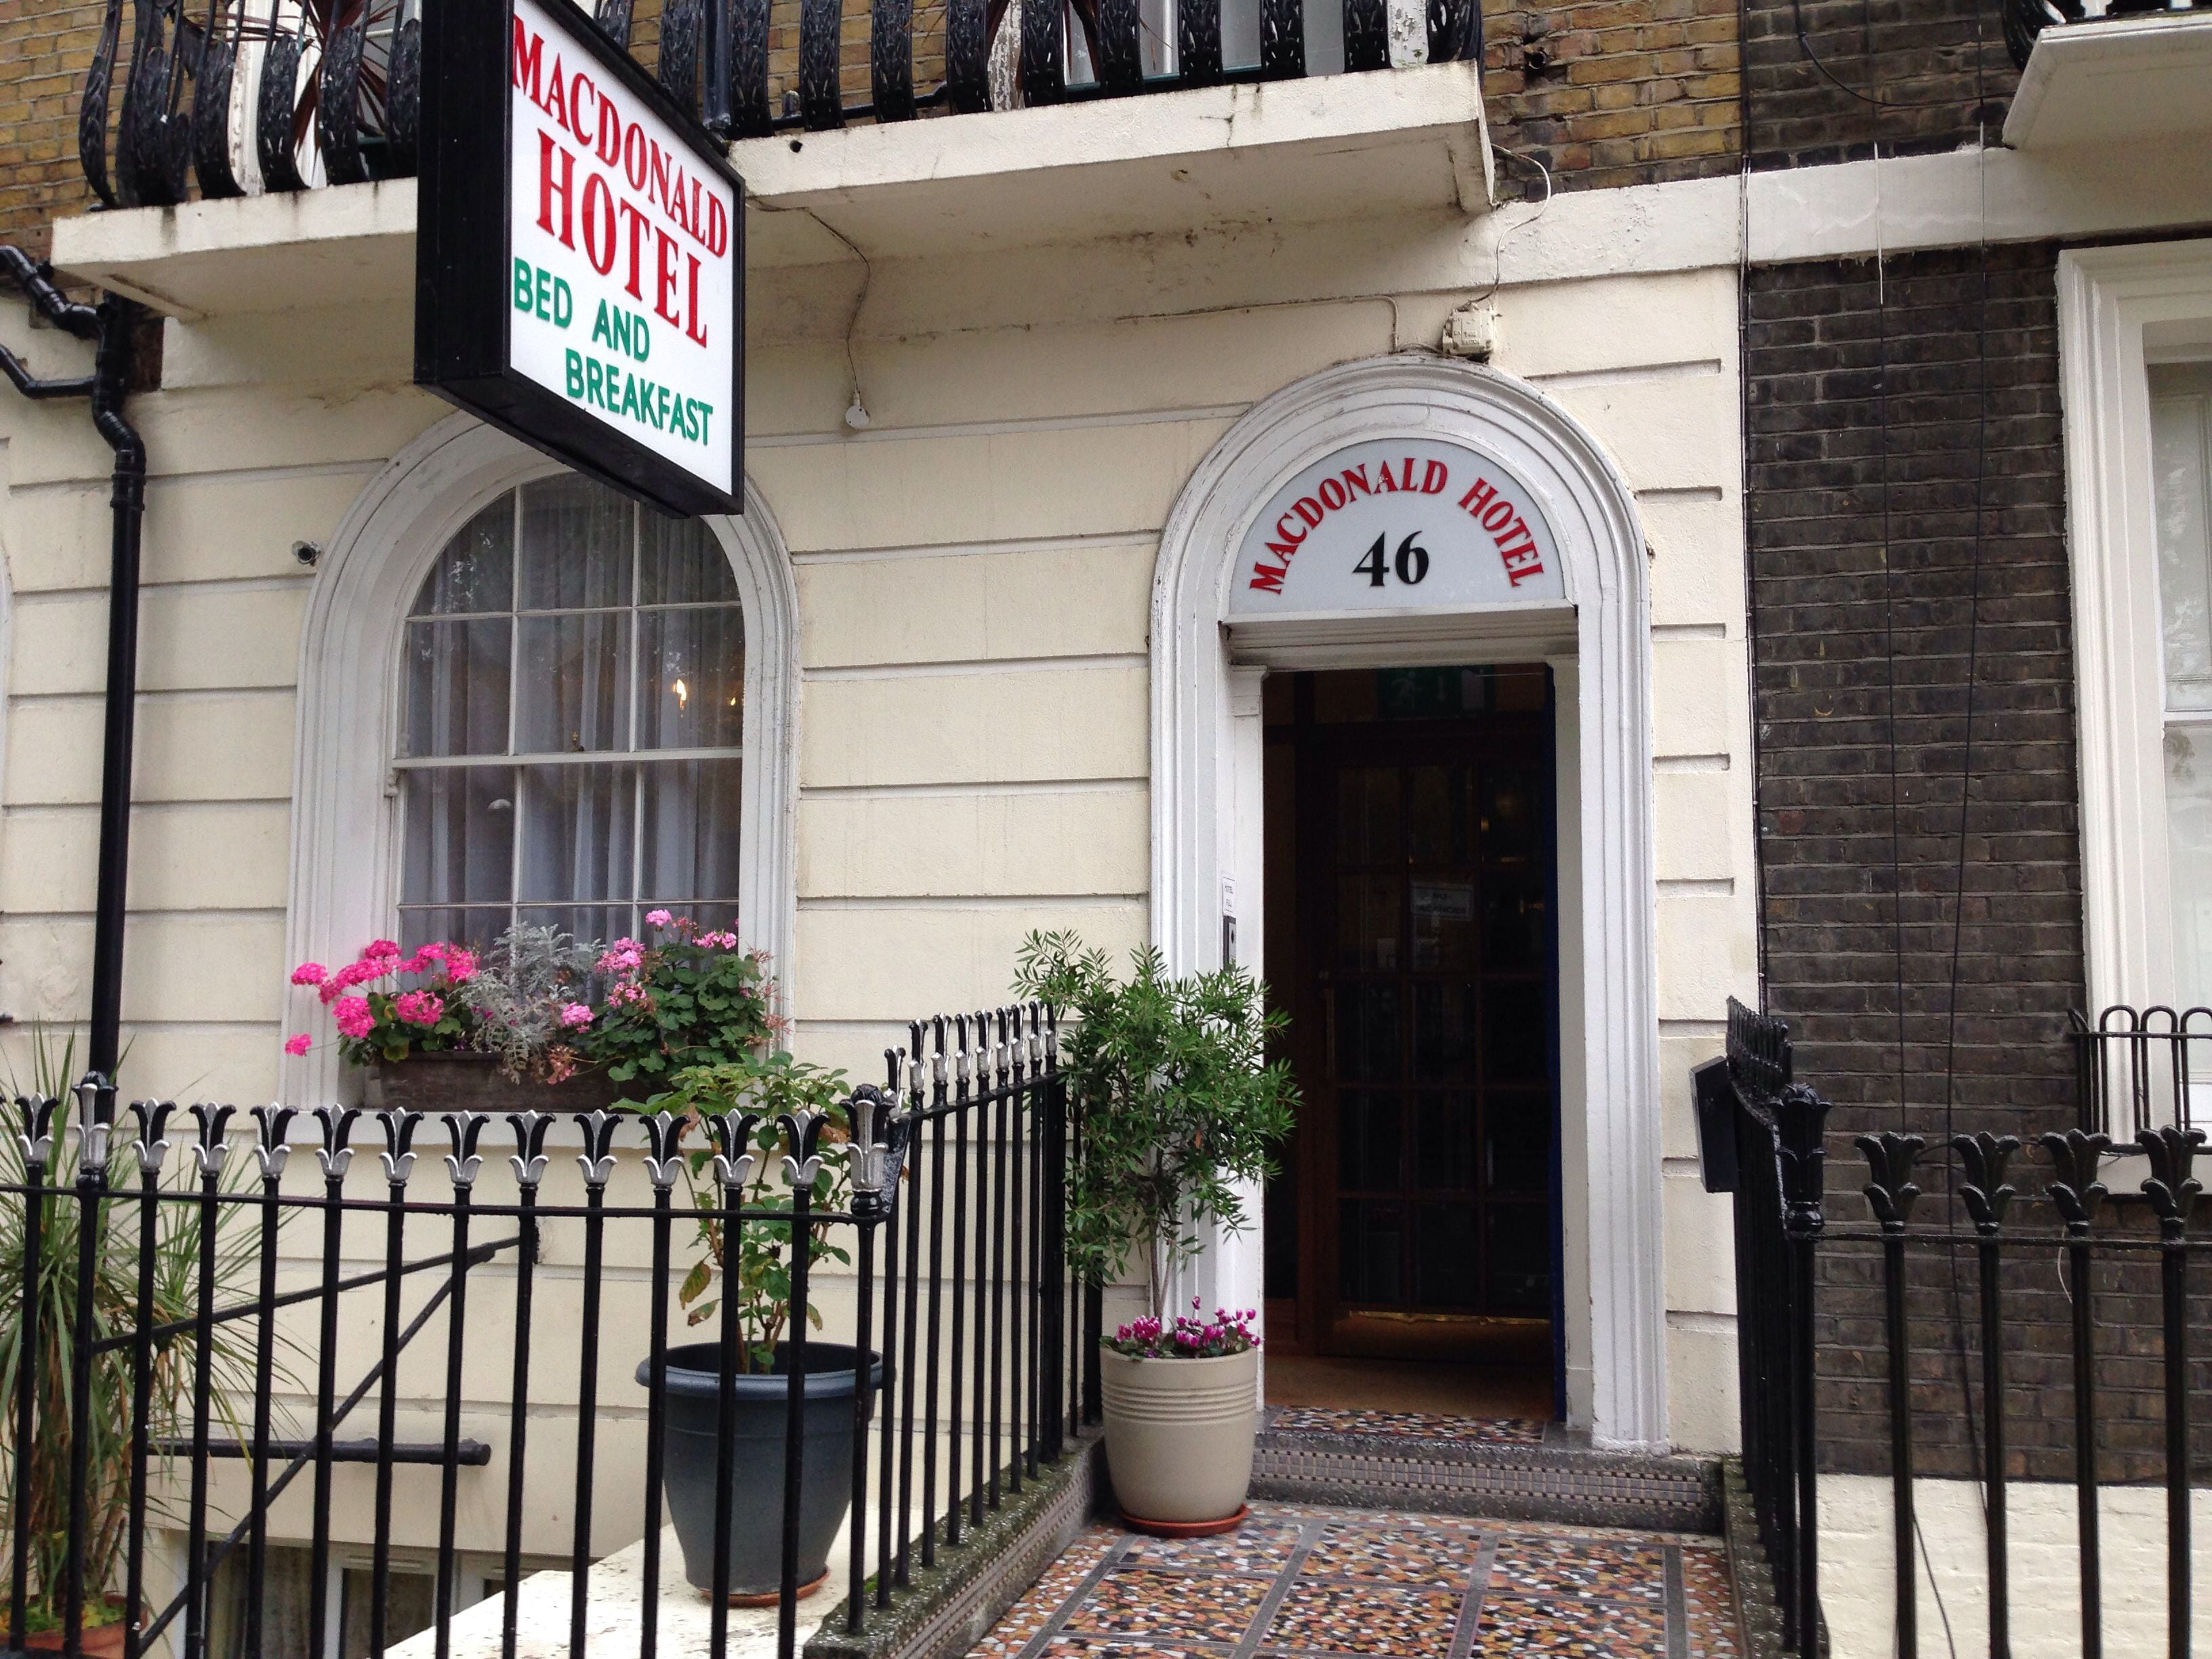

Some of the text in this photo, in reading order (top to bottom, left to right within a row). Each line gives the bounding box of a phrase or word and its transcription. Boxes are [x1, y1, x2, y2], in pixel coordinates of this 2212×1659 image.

[512, 14, 728, 258] MACDONALD
[537, 128, 708, 348] HOTEL
[513, 257, 651, 363] BED AND
[565, 346, 714, 447] BREAKFAST
[1249, 457, 1544, 595] MACDONALD HOTEL
[1352, 531, 1430, 587] 46
